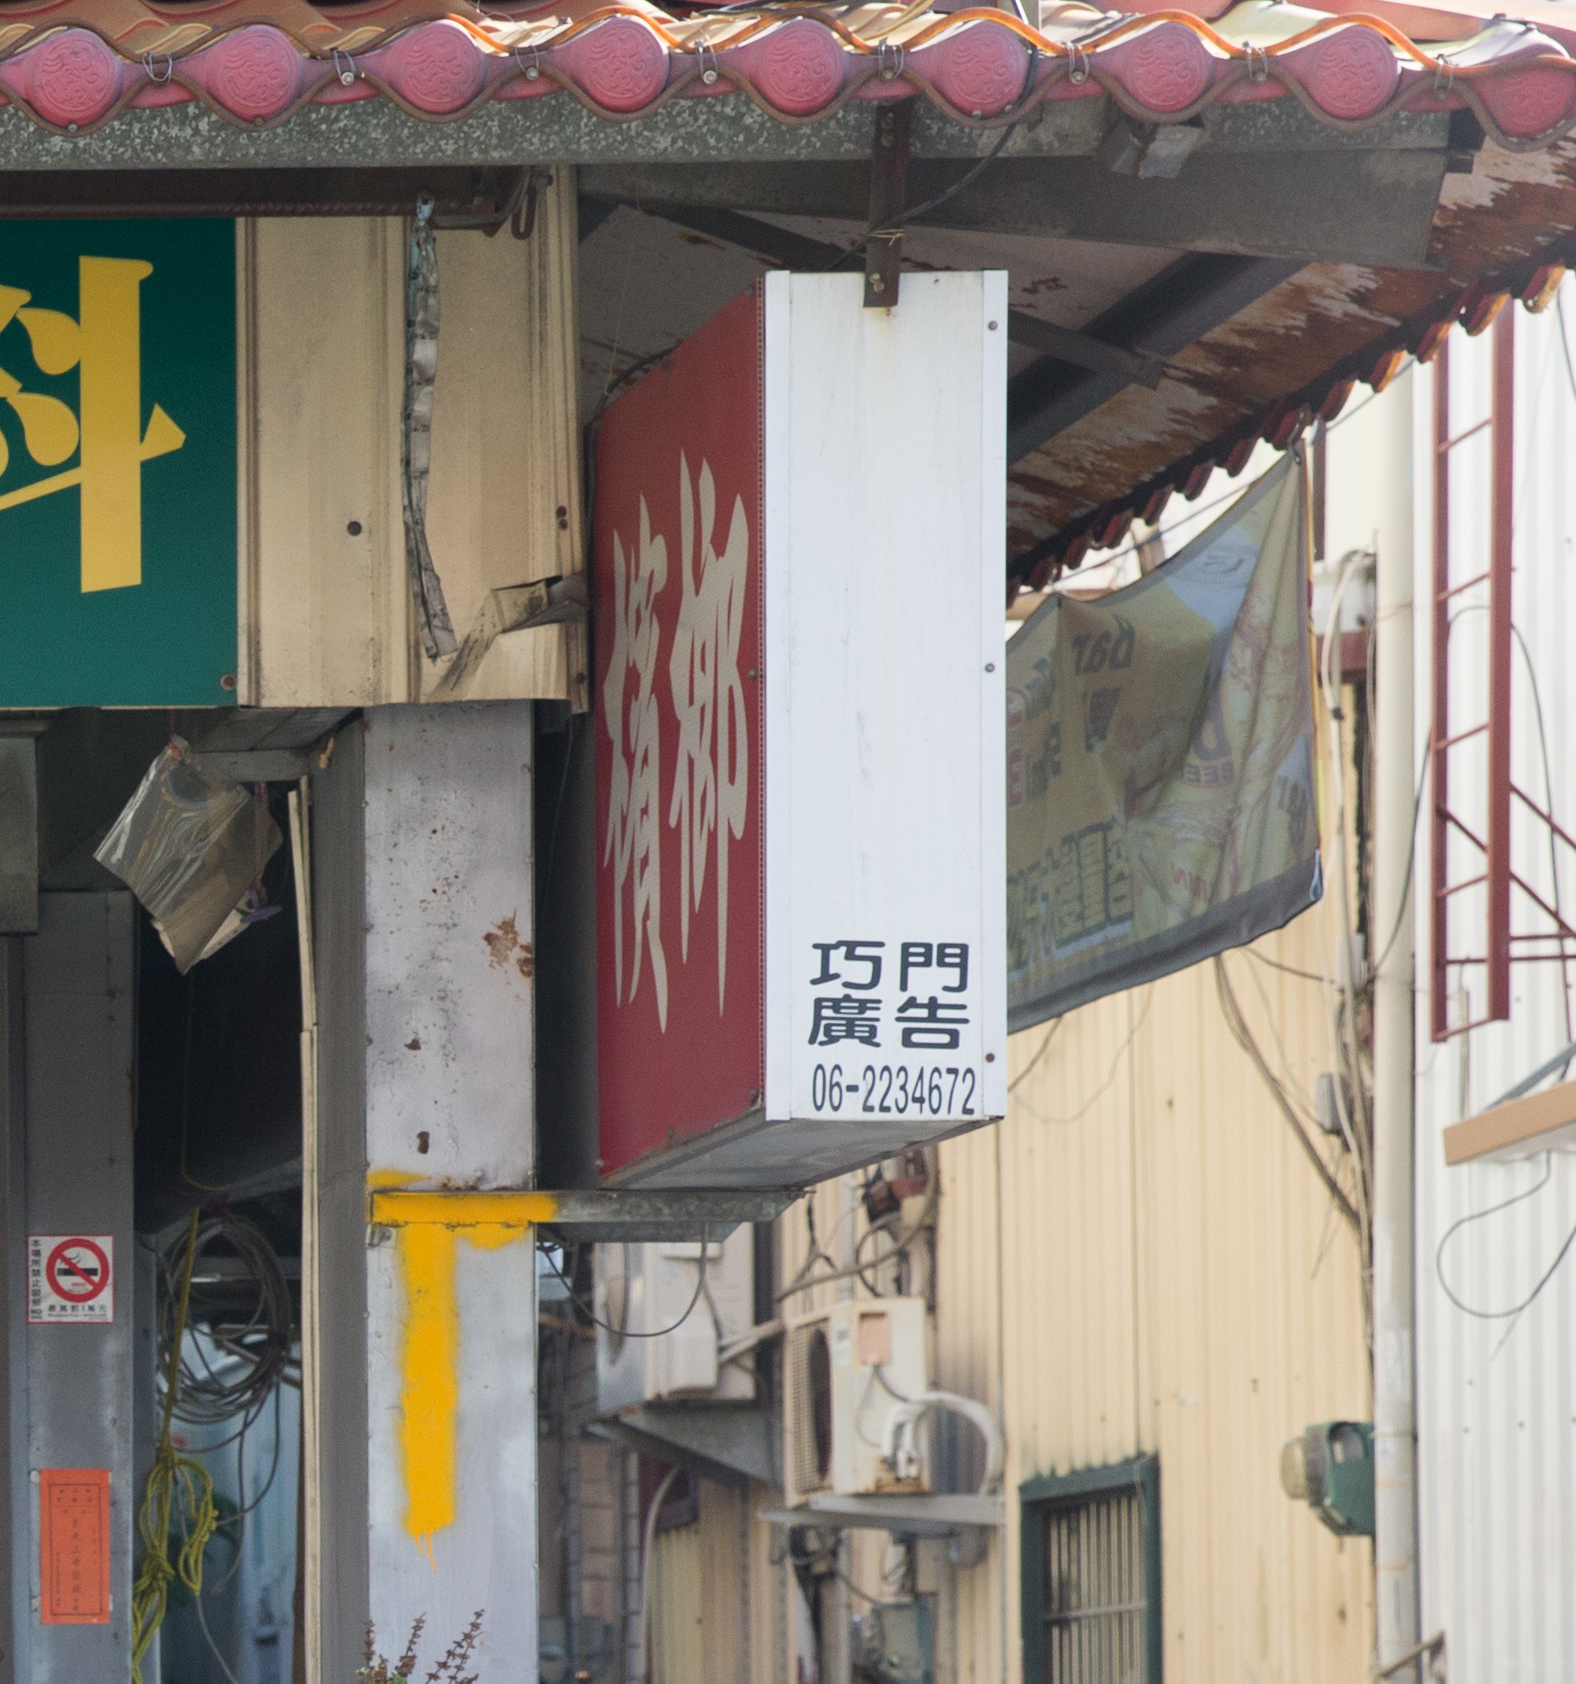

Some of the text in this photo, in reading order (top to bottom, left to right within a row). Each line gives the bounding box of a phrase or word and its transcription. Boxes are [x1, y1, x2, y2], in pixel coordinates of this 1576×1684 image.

[601, 448, 749, 1034] 檳榔
[809, 941, 969, 993] 巧門
[807, 994, 971, 1052] 廣告
[812, 1064, 977, 1117] 06-2234672
